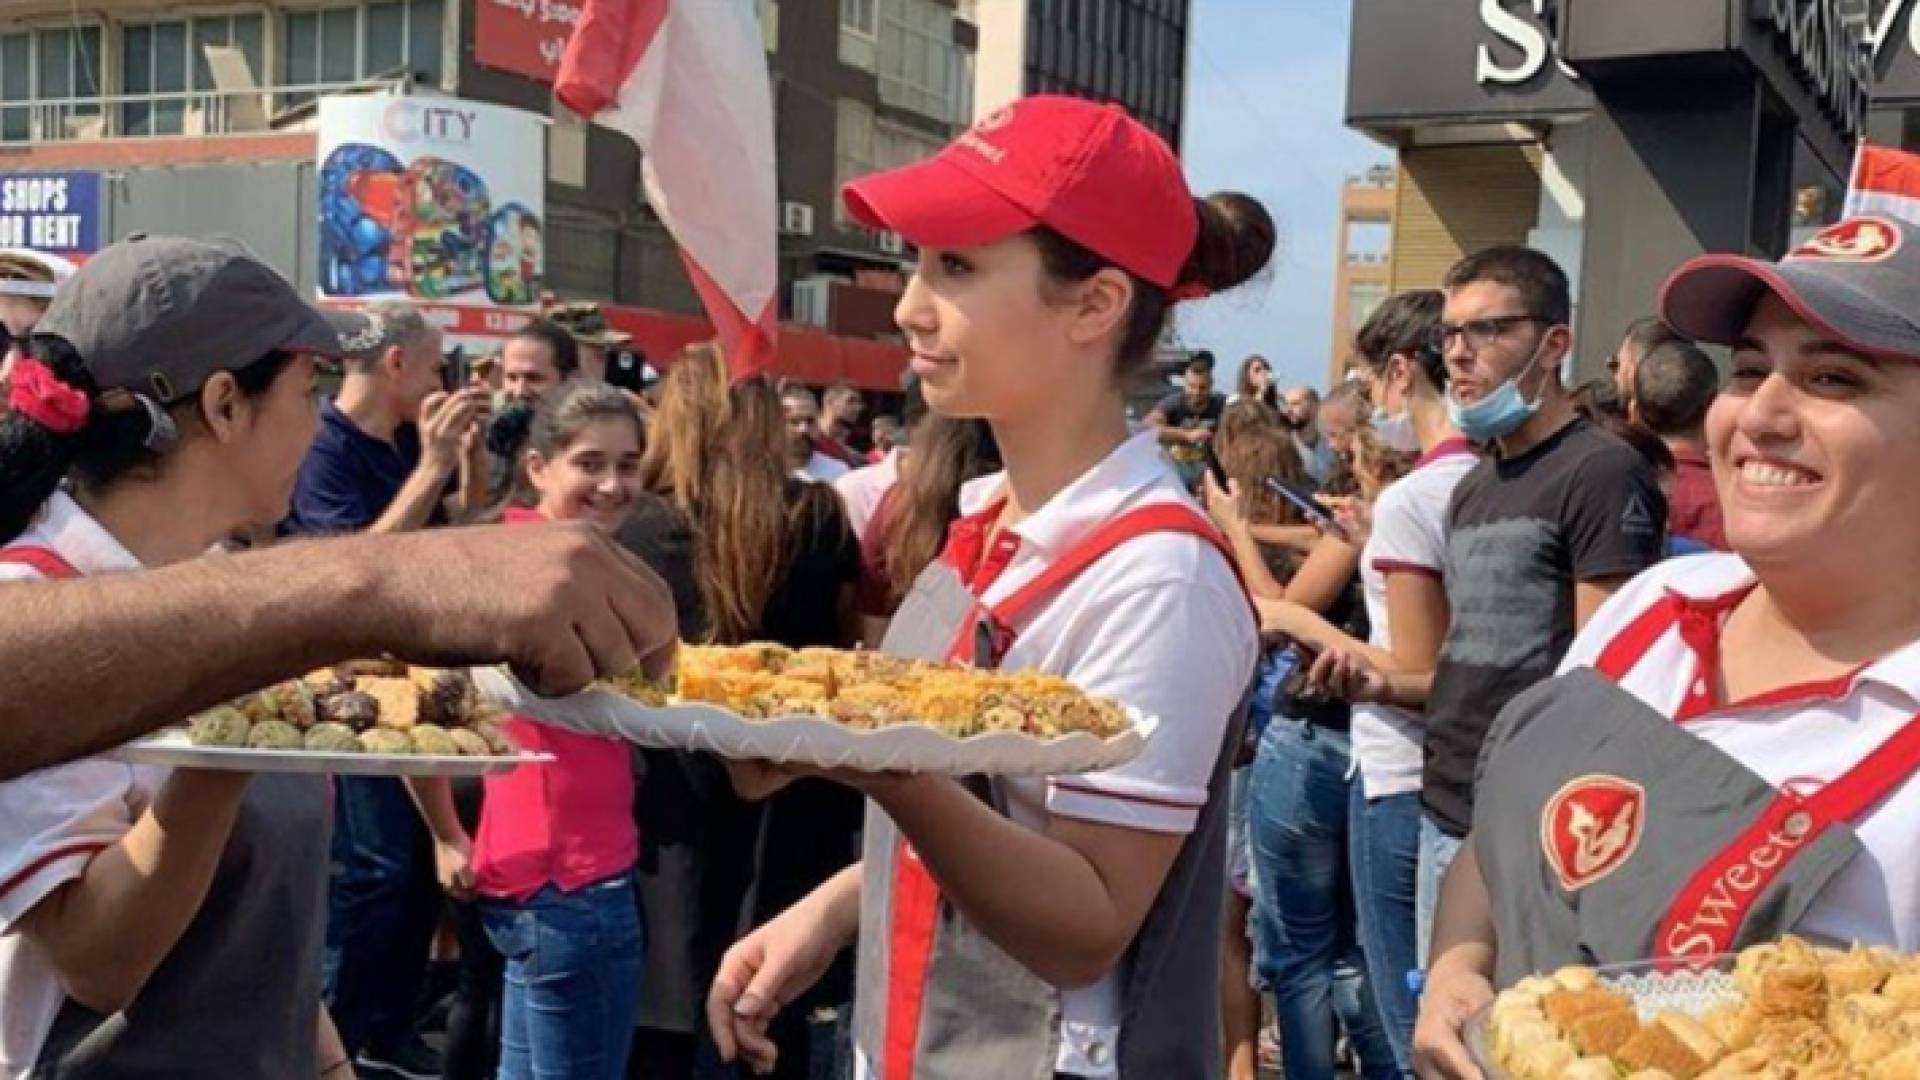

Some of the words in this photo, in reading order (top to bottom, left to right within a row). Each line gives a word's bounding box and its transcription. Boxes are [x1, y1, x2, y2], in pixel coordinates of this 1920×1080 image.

[383, 98, 477, 143] CITY
[2, 177, 69, 213] SHOPS
[30, 214, 82, 249] RENT
